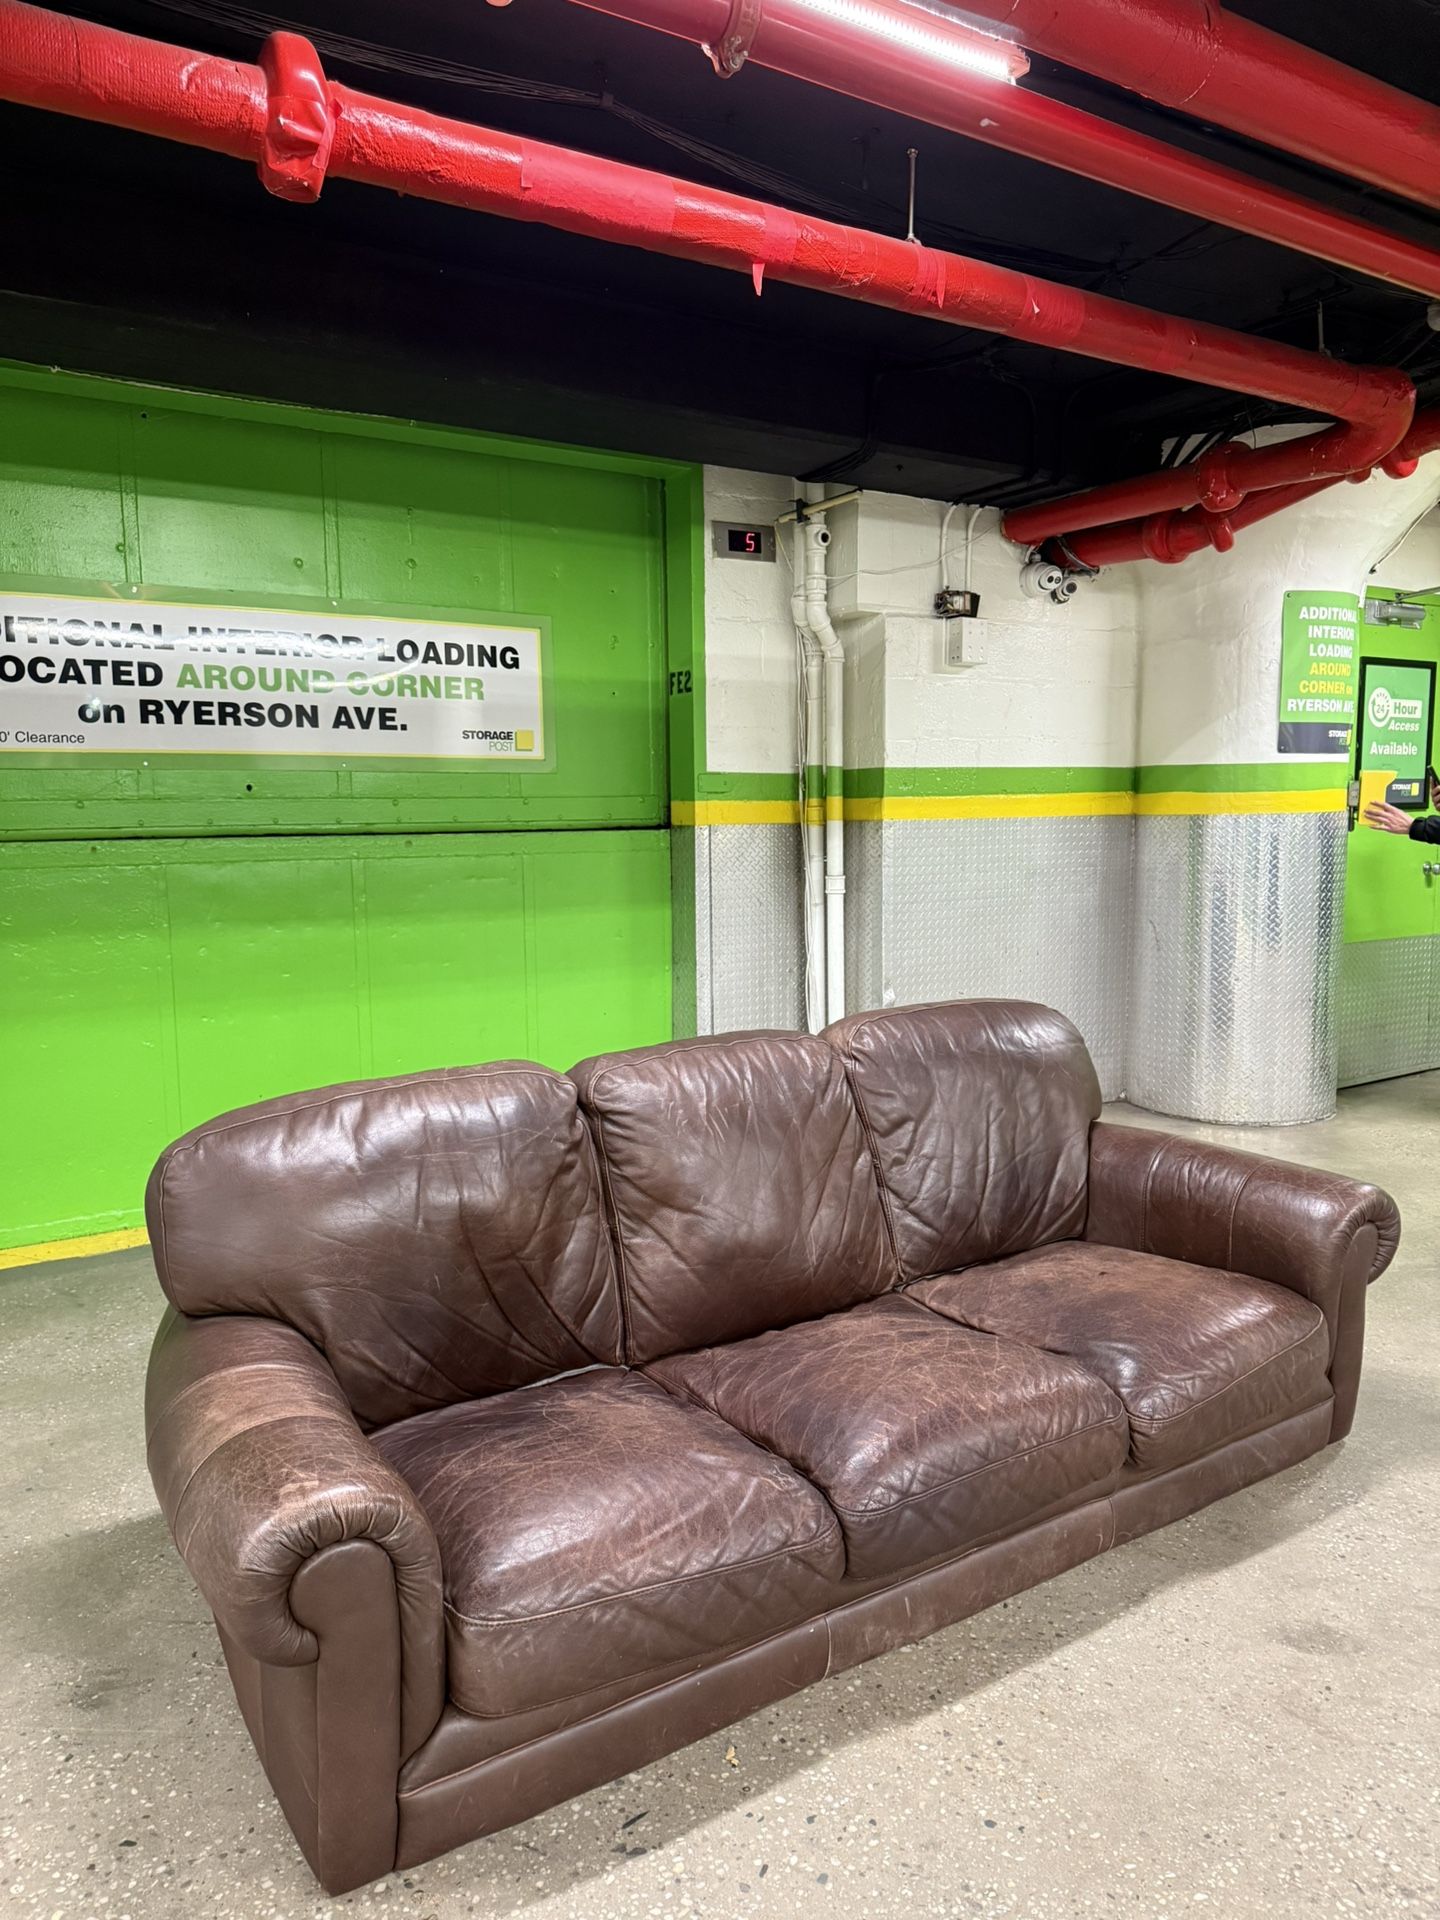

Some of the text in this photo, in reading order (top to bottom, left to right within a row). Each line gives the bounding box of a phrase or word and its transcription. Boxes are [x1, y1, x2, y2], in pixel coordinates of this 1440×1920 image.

[746, 533, 755, 552] 5
[1308, 625, 1355, 641] INTERIOR
[0, 615, 520, 670] ITIONAL INTERIOR LOADING
[1309, 662, 1352, 677] AROUND
[176, 663, 336, 694] AROUND
[347, 671, 485, 701] CORNER
[669, 670, 692, 696] FE2
[1299, 680, 1345, 695] CORNER
[1287, 698, 1342, 712] RYERSON
[1376, 701, 1418, 715] 24 Hour
[78, 698, 408, 731] on RYERSON AVE.
[1388, 719, 1420, 731] Access
[15, 731, 85, 744] Clearance
[462, 730, 514, 741] STORAGE
[489, 741, 514, 752] POST
[1370, 741, 1418, 756] Available
